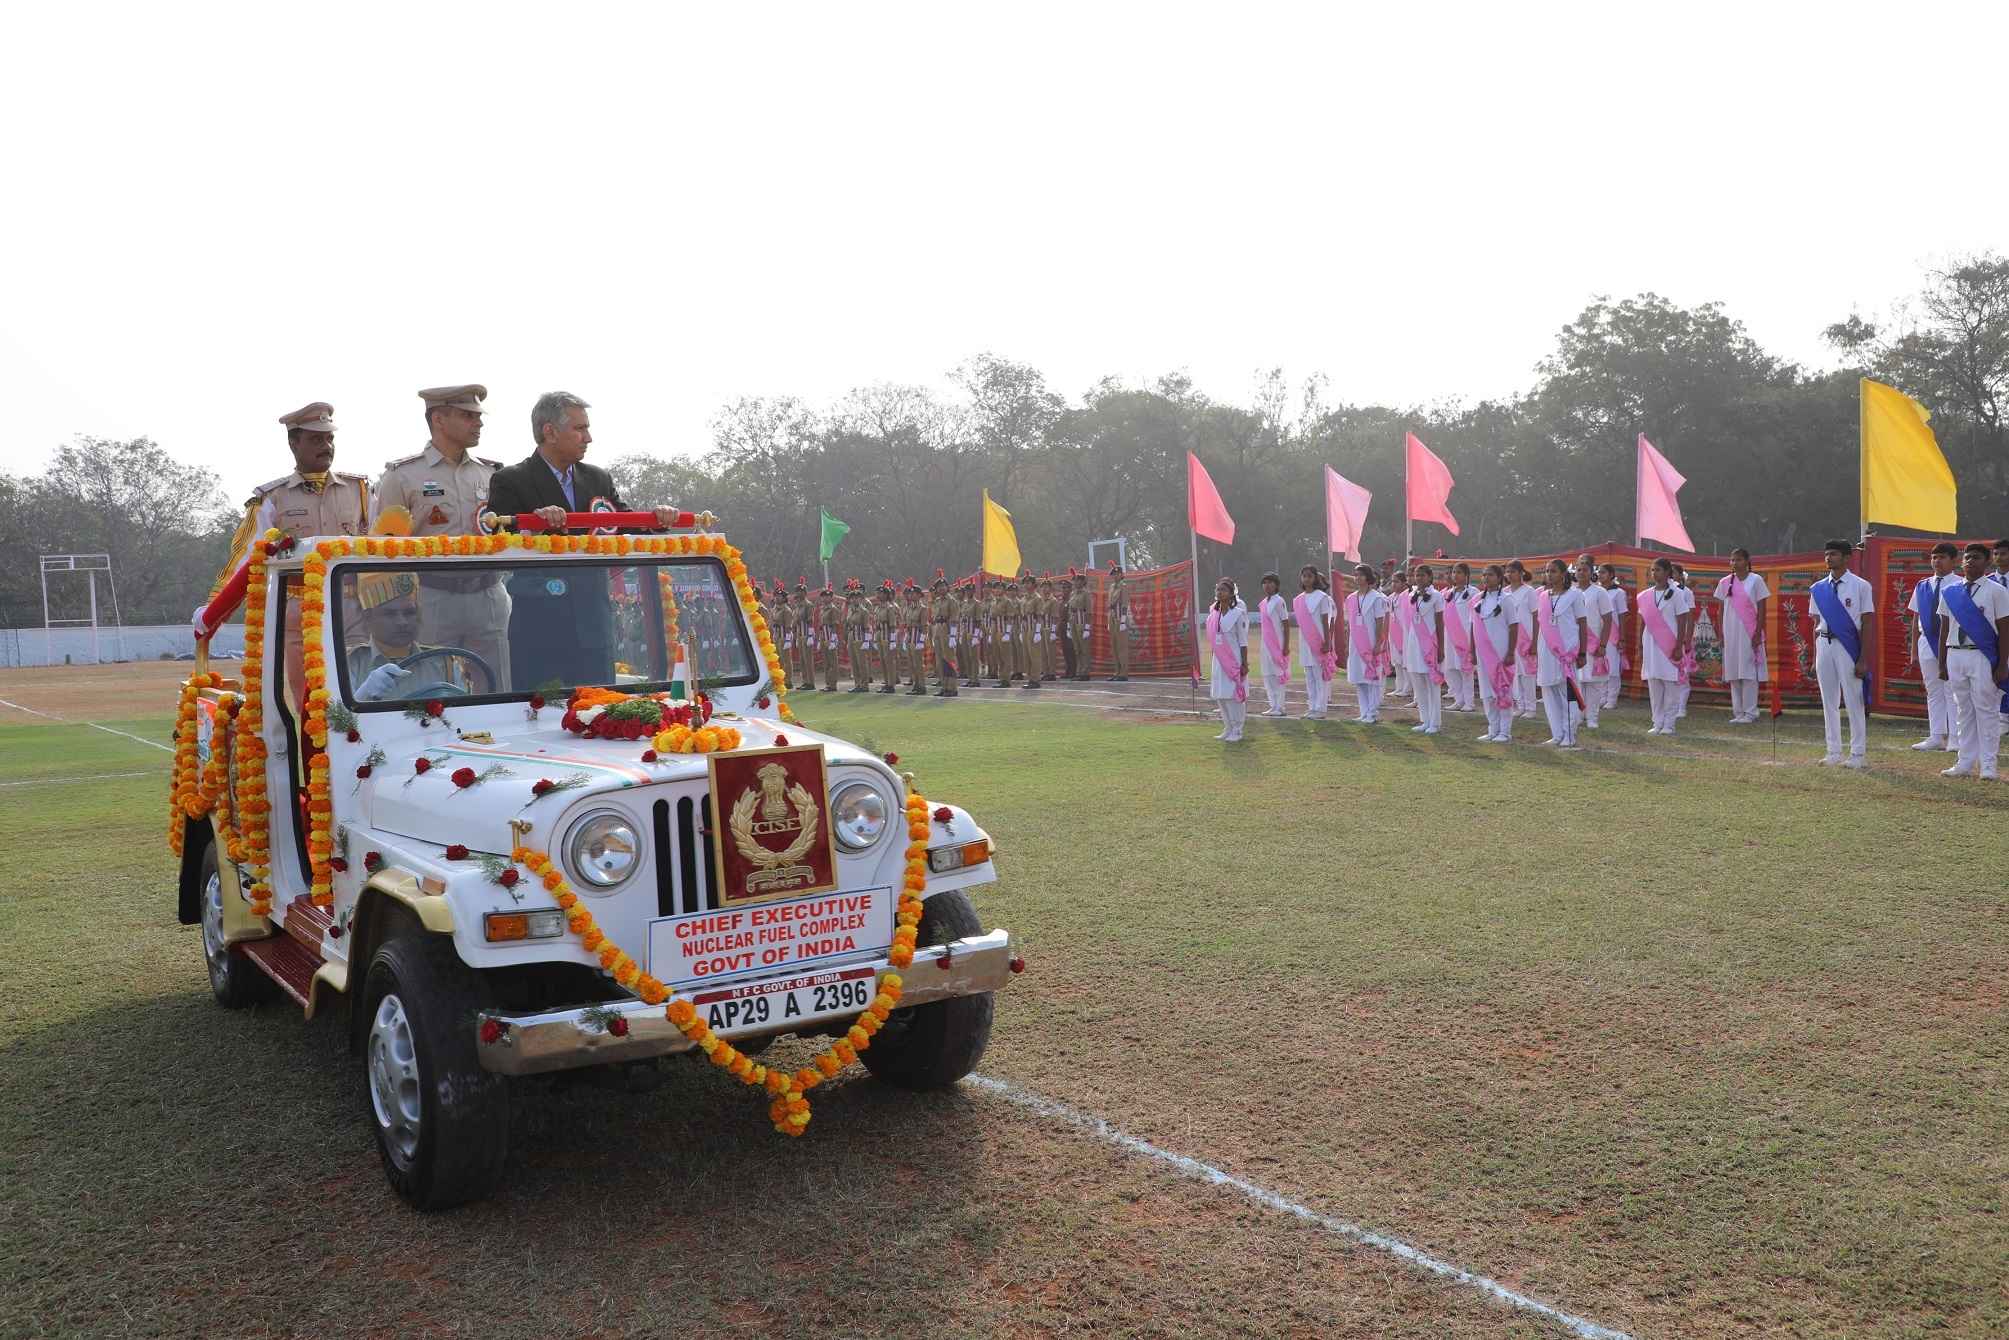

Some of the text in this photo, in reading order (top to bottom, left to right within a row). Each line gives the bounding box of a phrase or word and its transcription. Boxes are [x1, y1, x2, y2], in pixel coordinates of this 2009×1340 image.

[754, 819, 796, 835] CISF
[675, 895, 872, 939] CHIEF EXECUTIVE
[682, 913, 865, 958] NUCLEAR FUEL COMPLEX
[693, 935, 856, 977] GOVT OF INDIA
[708, 980, 868, 1029] AP29 A 2396
[732, 973, 842, 998] N F C GOVT. OF INDIA
